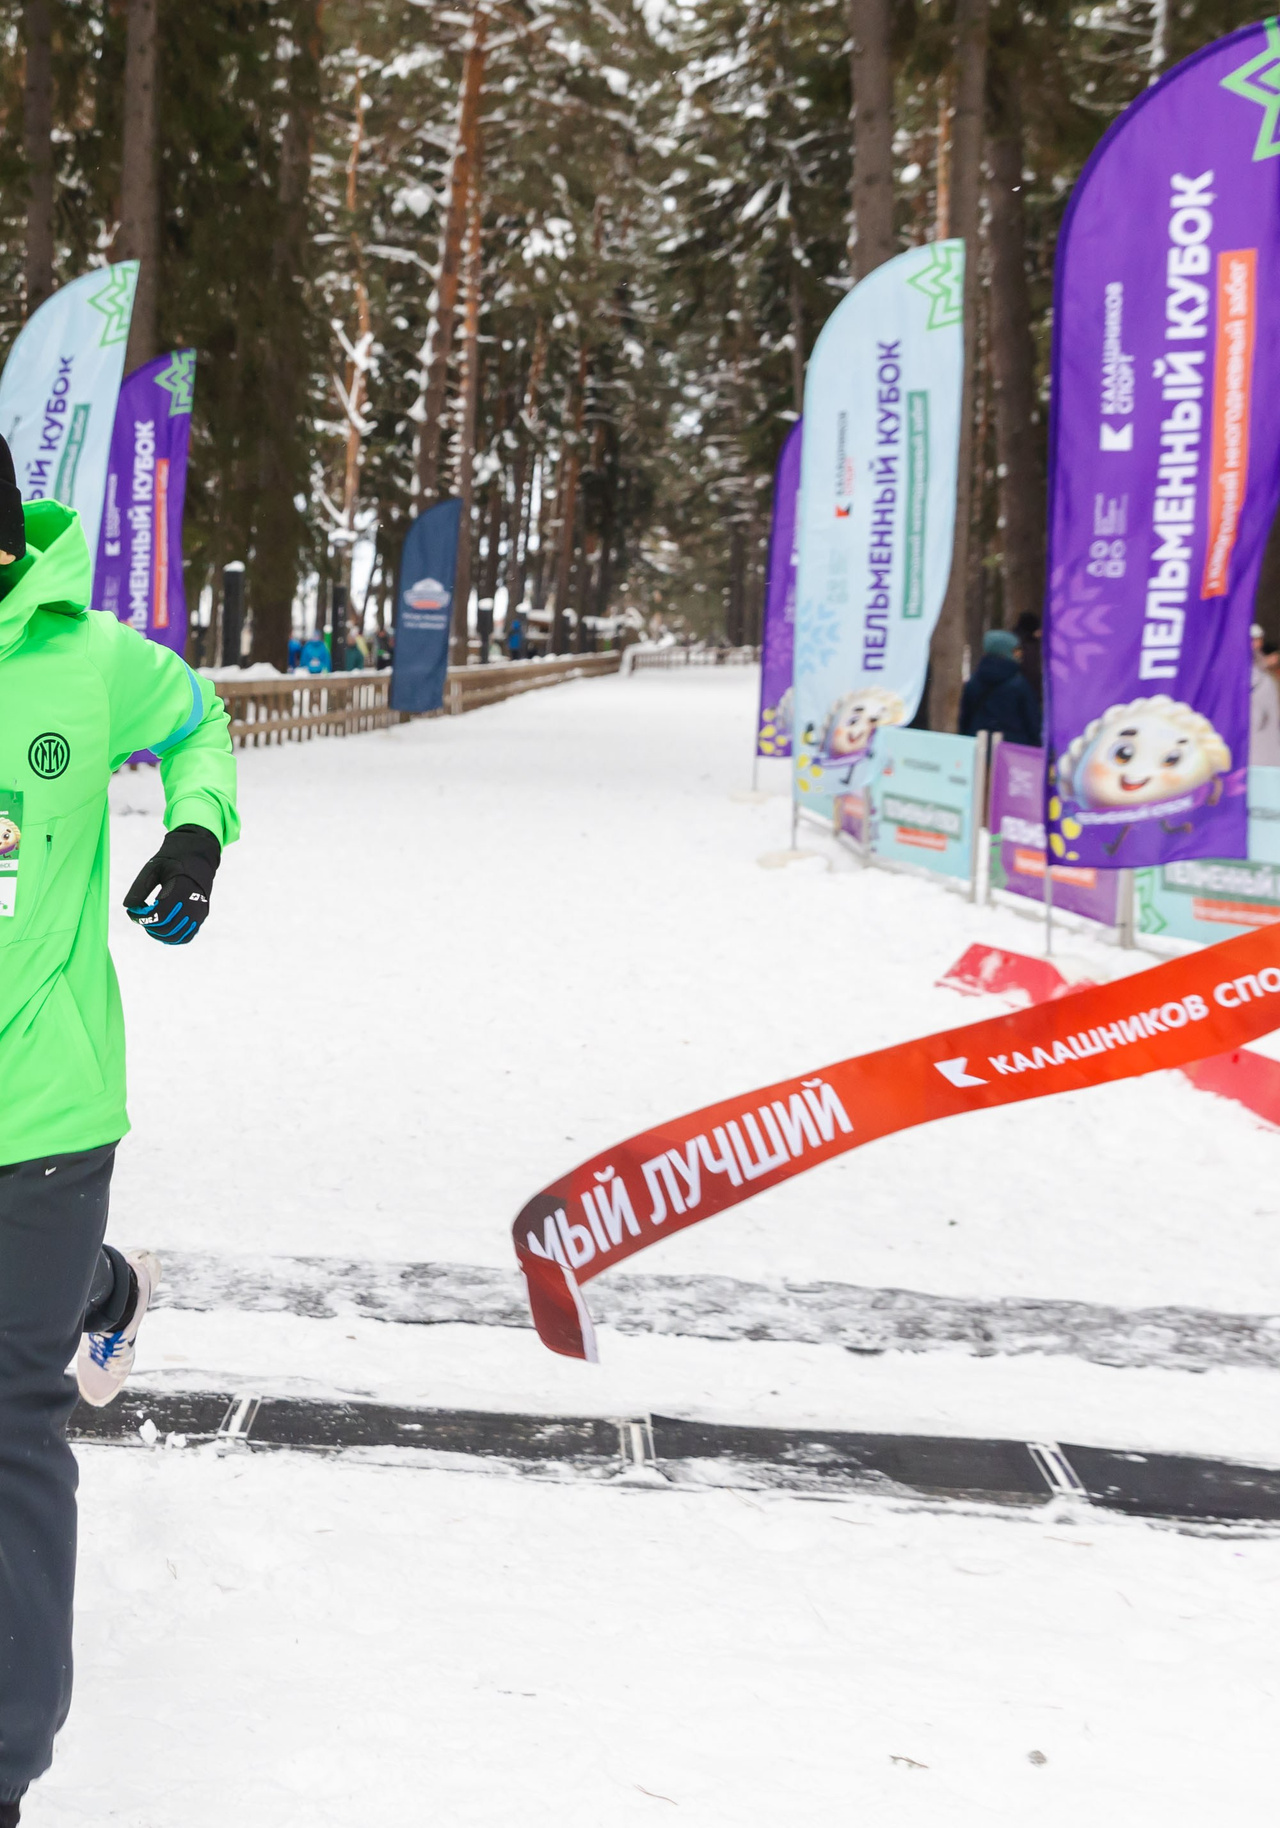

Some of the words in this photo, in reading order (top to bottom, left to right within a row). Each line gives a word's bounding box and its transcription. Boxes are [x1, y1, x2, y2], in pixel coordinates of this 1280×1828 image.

[1165, 169, 1214, 340] КУБОК
[40, 356, 74, 451] КУБОК
[877, 339, 902, 446] КУБОК
[1117, 354, 1136, 414] СПОРТ
[133, 421, 155, 499] КУБОК
[1139, 350, 1206, 680] ПЕЛЬМЕННЫЙ
[126, 504, 152, 639] ЛЬМЕННЫЙ
[863, 455, 899, 671] ПЕЛЬМЕННЫЙ
[987, 994, 1210, 1075] КАЛАШНИКОВ
[641, 1078, 854, 1226] ЛУЧШИЙ
